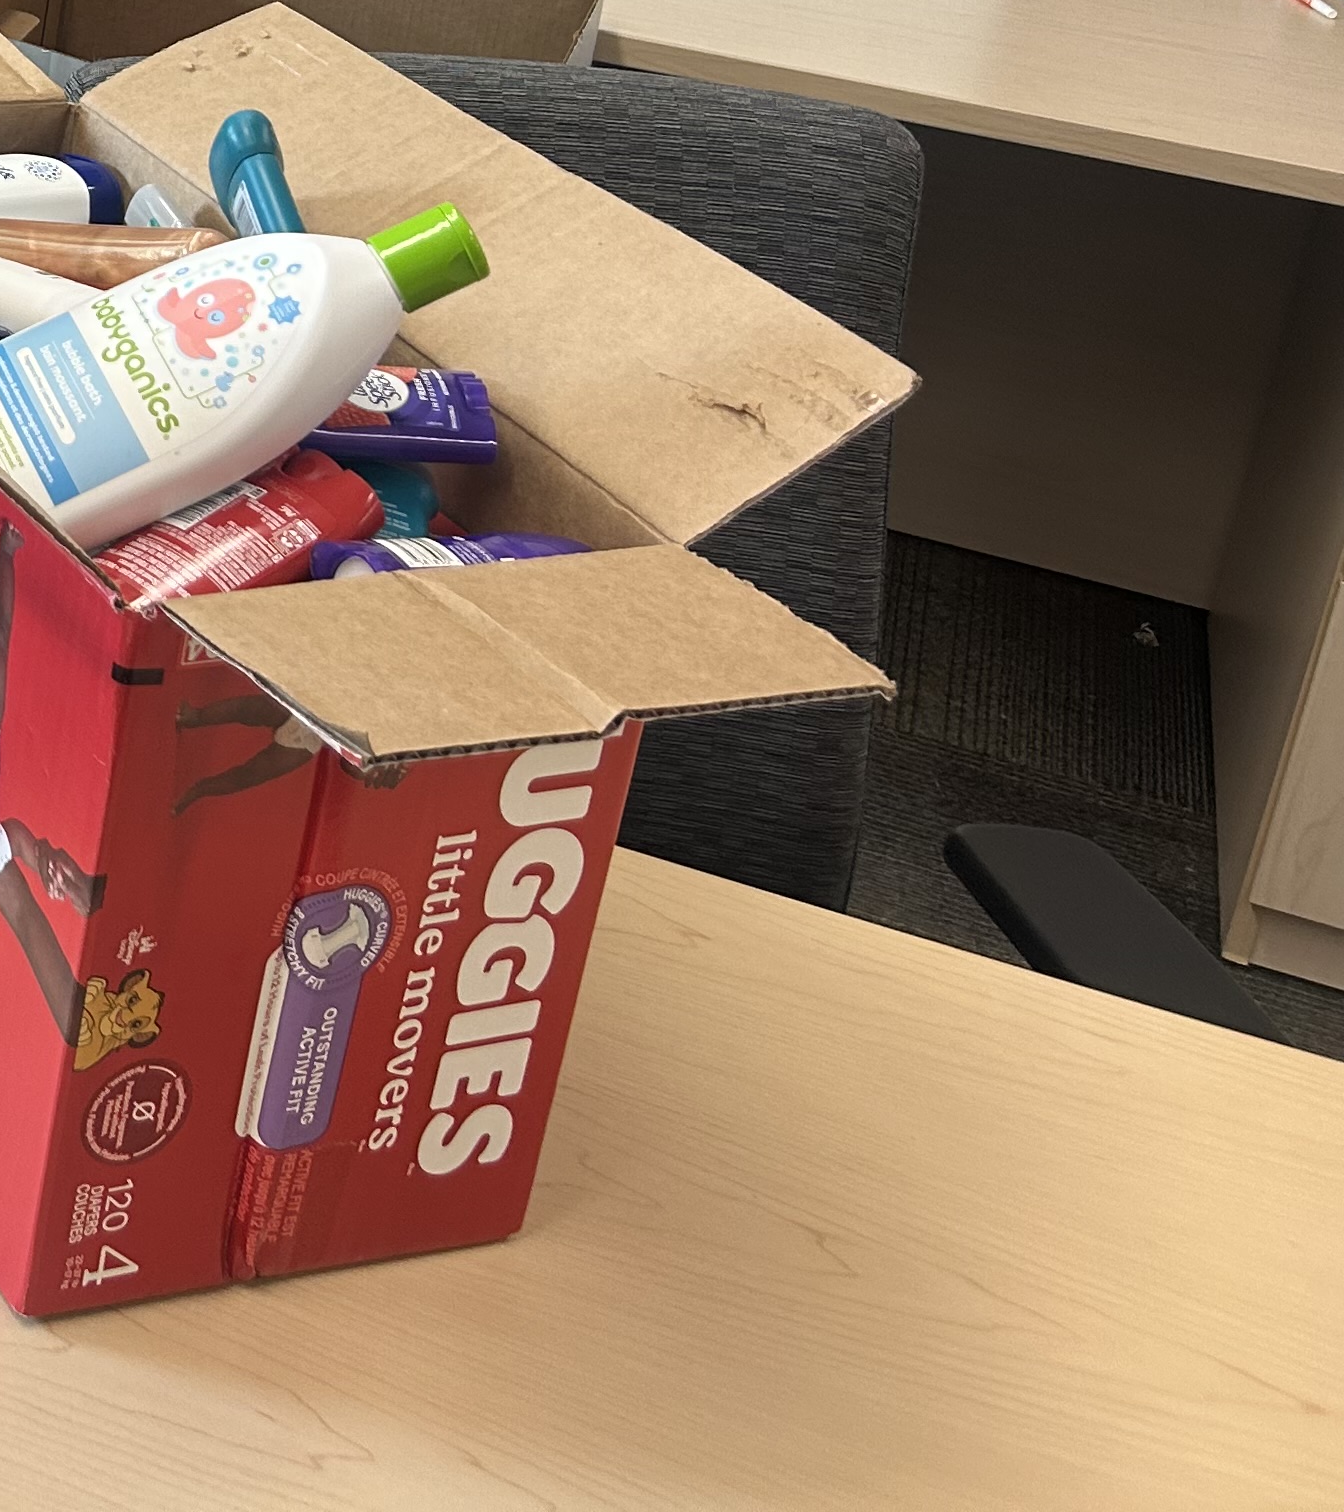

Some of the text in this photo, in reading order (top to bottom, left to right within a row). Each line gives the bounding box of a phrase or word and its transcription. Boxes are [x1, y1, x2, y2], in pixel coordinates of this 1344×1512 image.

[40, 344, 86, 424] bain moussant
[62, 340, 103, 407] bubble bath
[91, 294, 179, 434] babyganics
[285, 888, 388, 991] HUGGIES CURVED & STRETCHY FIT
[315, 868, 358, 887] COUPE
[375, 904, 408, 974] EXTENSIBLE
[416, 739, 605, 1176] UGGIES
[368, 829, 477, 1151] little movers
[285, 1026, 317, 1114] ACTIVE FIT
[300, 1007, 338, 1126] OUTSTANDING
[68, 1183, 91, 1245] COUCHES
[83, 1184, 105, 1237] DIAPERS
[102, 1178, 134, 1232] 120
[263, 1152, 295, 1243] REMARQUABLE
[281, 1149, 313, 1238] ACTIVE FIT EST
[81, 1244, 139, 1287] 4
